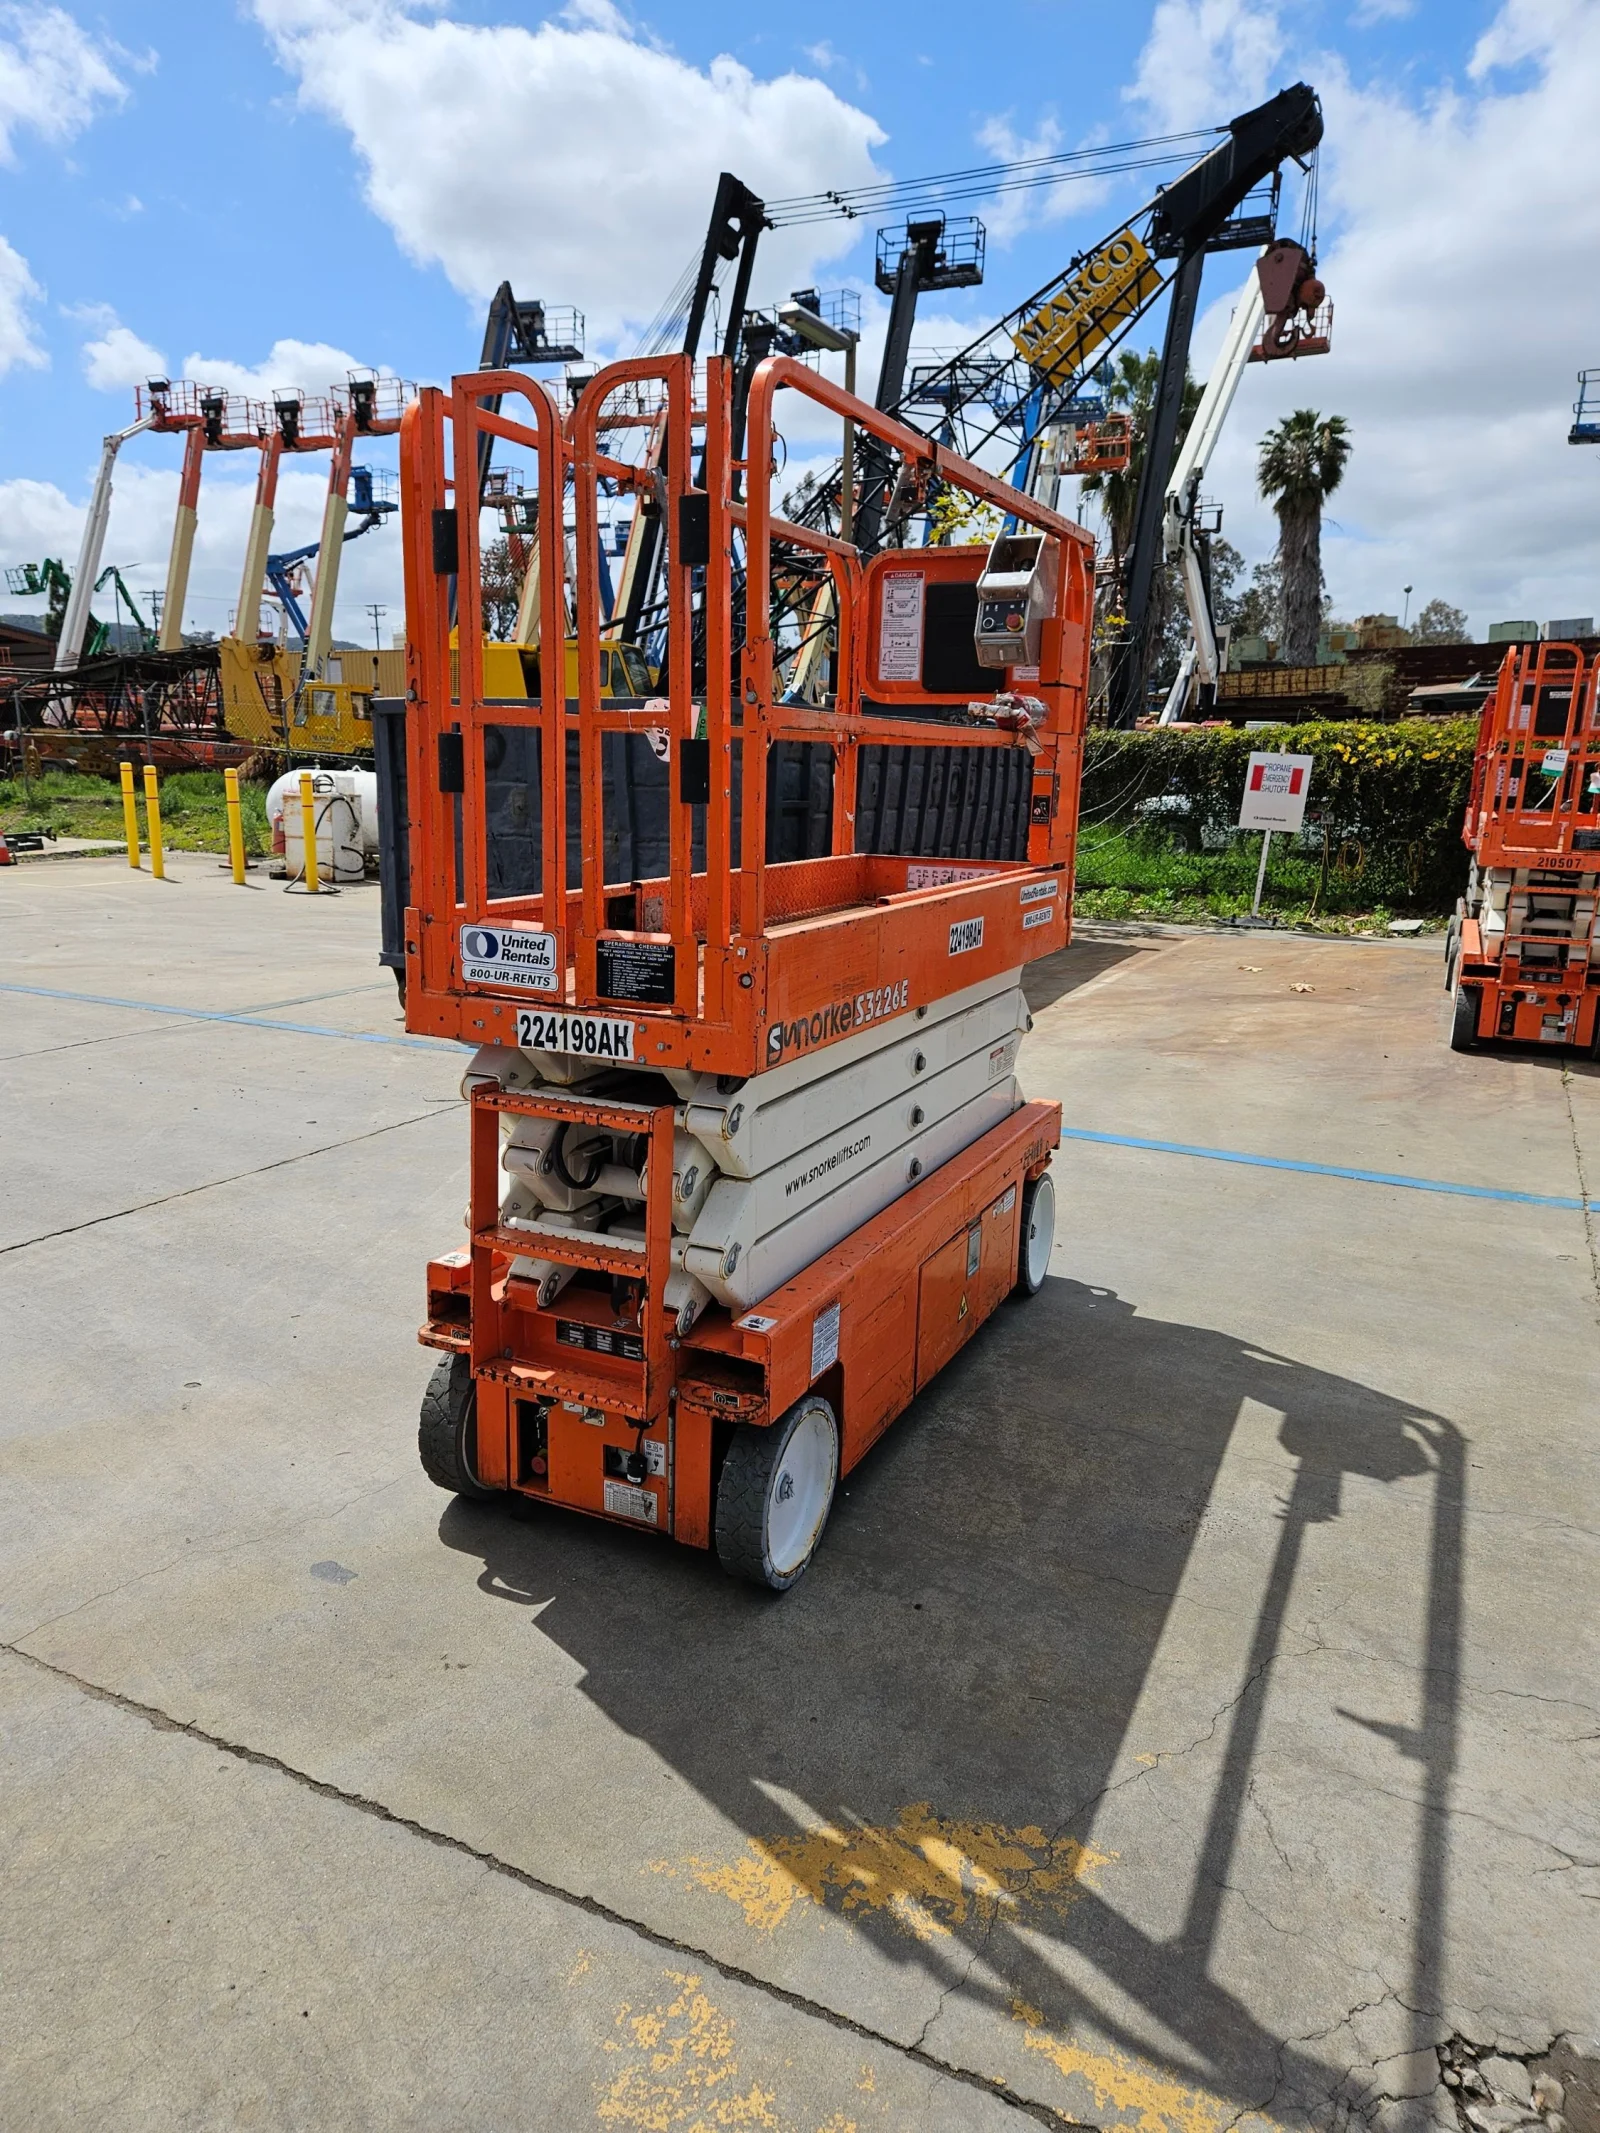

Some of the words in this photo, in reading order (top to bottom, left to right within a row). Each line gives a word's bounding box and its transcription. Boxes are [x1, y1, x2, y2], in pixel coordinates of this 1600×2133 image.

[1018, 240, 1134, 352] MARCO
[1078, 274, 1122, 314] RIGGING
[1264, 763, 1292, 772] PROPANE
[1262, 773, 1290, 783] EMERGENCY
[1261, 784, 1288, 794] SHUTOFF
[1537, 857, 1582, 869] 210507
[501, 934, 546, 951] United
[949, 920, 983, 954] 224198AH
[501, 948, 550, 966] Rentals
[469, 968, 551, 987] 800-UR-RENTS
[855, 979, 909, 1027] S3226E
[519, 1014, 630, 1057] 224198AH
[785, 1134, 871, 1198] www.snorkellifts.com
